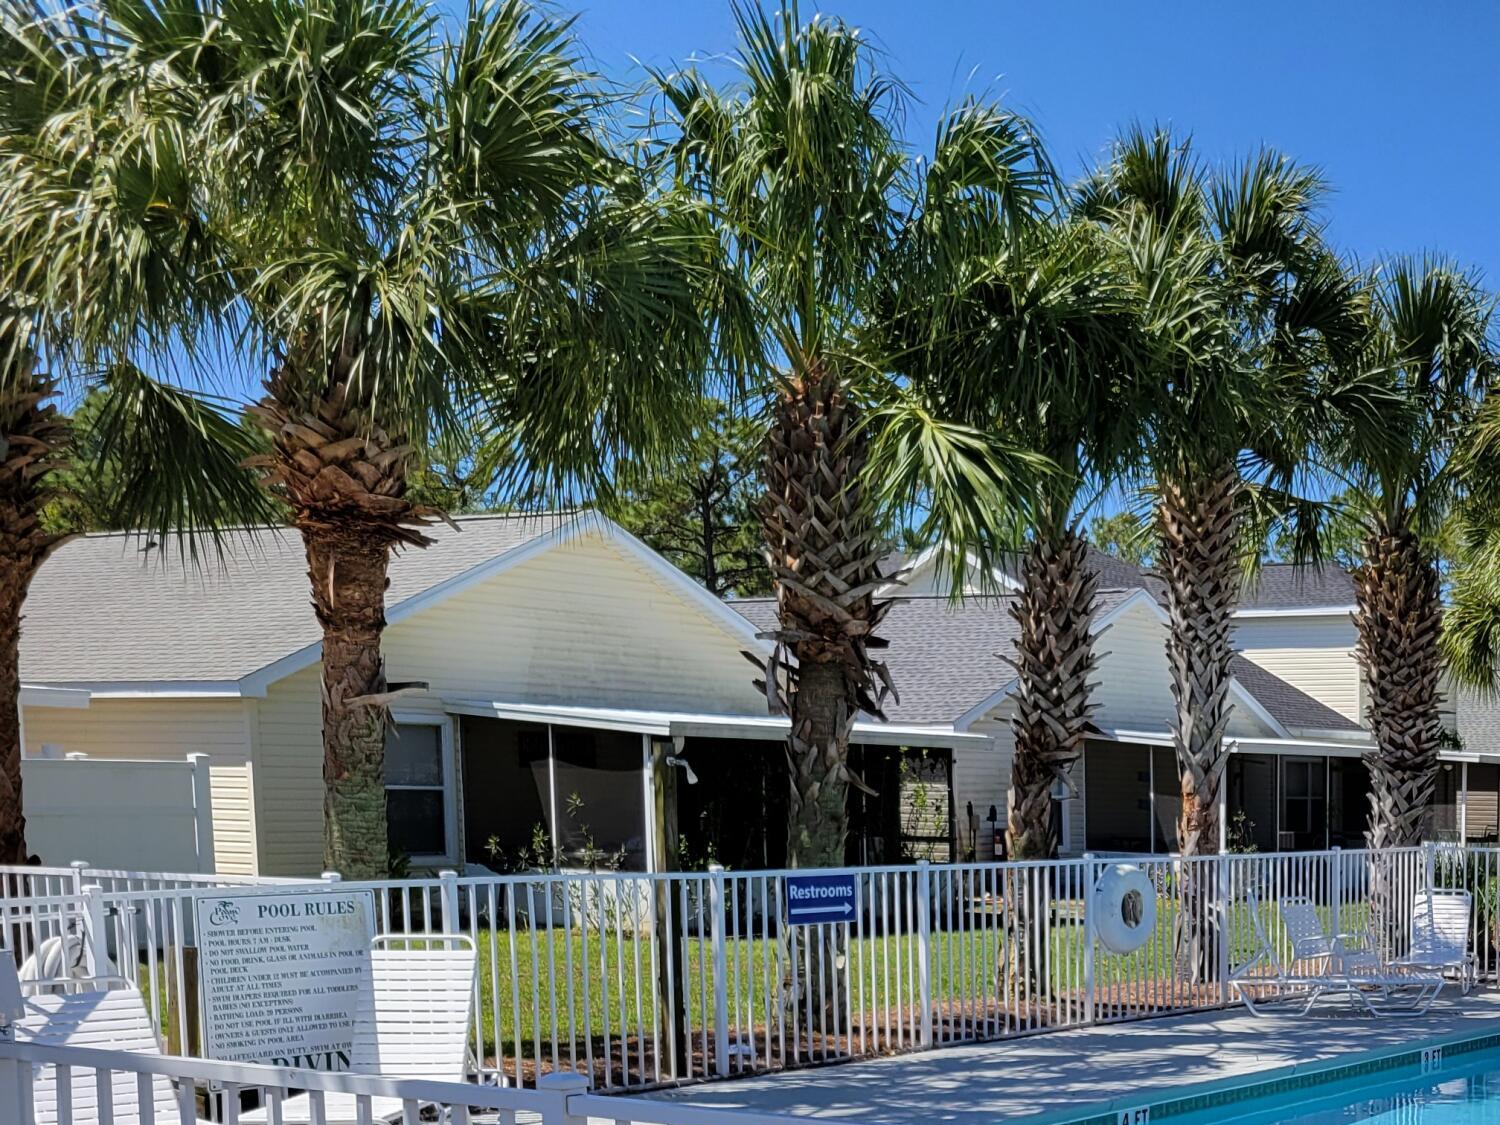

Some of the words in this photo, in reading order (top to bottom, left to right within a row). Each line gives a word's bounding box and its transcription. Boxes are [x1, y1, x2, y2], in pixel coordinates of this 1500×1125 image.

[790, 885, 852, 900] Restrooms
[257, 903, 300, 918] POOL
[304, 900, 354, 915] RULES
[207, 929, 235, 937] SHOWER
[265, 925, 298, 933] ENTERING
[299, 952, 328, 960] ANIMALS
[210, 975, 245, 984] CHILDREN
[310, 967, 353, 976] ACCOMPANIED
[212, 985, 233, 993] ADULT
[261, 981, 281, 989] TIMES
[232, 992, 261, 1000] DIAPERS
[263, 989, 297, 998] REQUIRED
[213, 1002, 237, 1010] BABIES
[213, 1012, 243, 1020] BATHING
[274, 1006, 302, 1015] PERSONS
[225, 1021, 239, 1029] NOT
[314, 1012, 347, 1021] DIARRHEA
[214, 1030, 243, 1039] OWNERS
[251, 1027, 276, 1036] GUESTS
[296, 1023, 327, 1032] ALLOWED
[226, 1039, 255, 1048] SMOKING
[267, 1036, 284, 1044] POOL
[286, 1034, 304, 1042] AREA
[229, 1050, 272, 1060] LIFEGUARD
[310, 1044, 329, 1052] SWIM
[272, 1050, 353, 1072] DIVIN
[1134, 1108, 1149, 1124] FT
